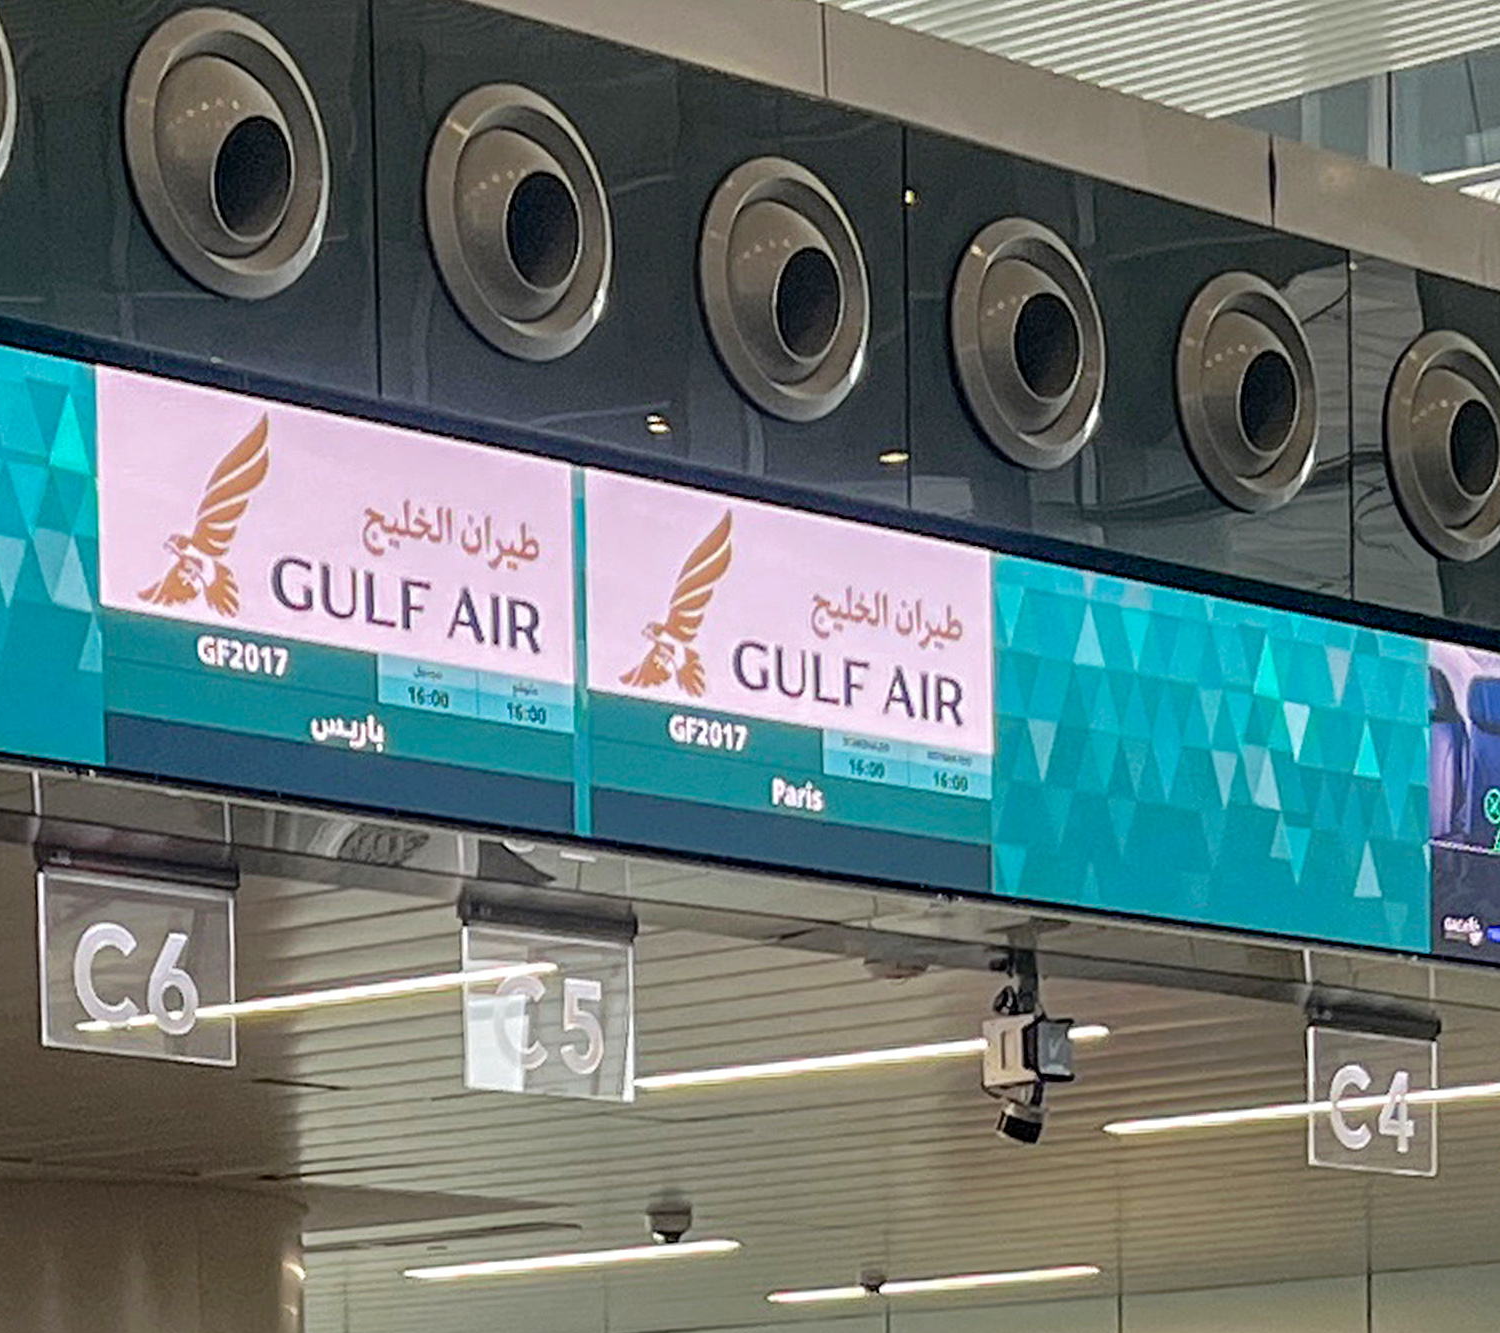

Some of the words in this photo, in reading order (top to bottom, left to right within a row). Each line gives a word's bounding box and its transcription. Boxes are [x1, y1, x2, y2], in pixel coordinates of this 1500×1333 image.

[362, 498, 454, 557] الخليج
[459, 510, 540, 571] طيران
[270, 556, 431, 633] GULF
[447, 586, 541, 655] AIR
[810, 586, 890, 637] الخليج
[895, 598, 963, 648] طيران
[198, 636, 288, 677] GF2017
[408, 686, 449, 709] 16:00
[507, 702, 546, 725] 16:00
[732, 640, 870, 708] GULF
[884, 666, 963, 727] AIR
[310, 714, 384, 752] باريس
[669, 714, 748, 751] GF2017
[771, 777, 825, 812] Paris
[849, 759, 885, 779] 16:00
[933, 771, 968, 792] 16:00
[73, 921, 201, 1036] C6
[495, 973, 606, 1076] C5
[1328, 1063, 1414, 1154] C4
